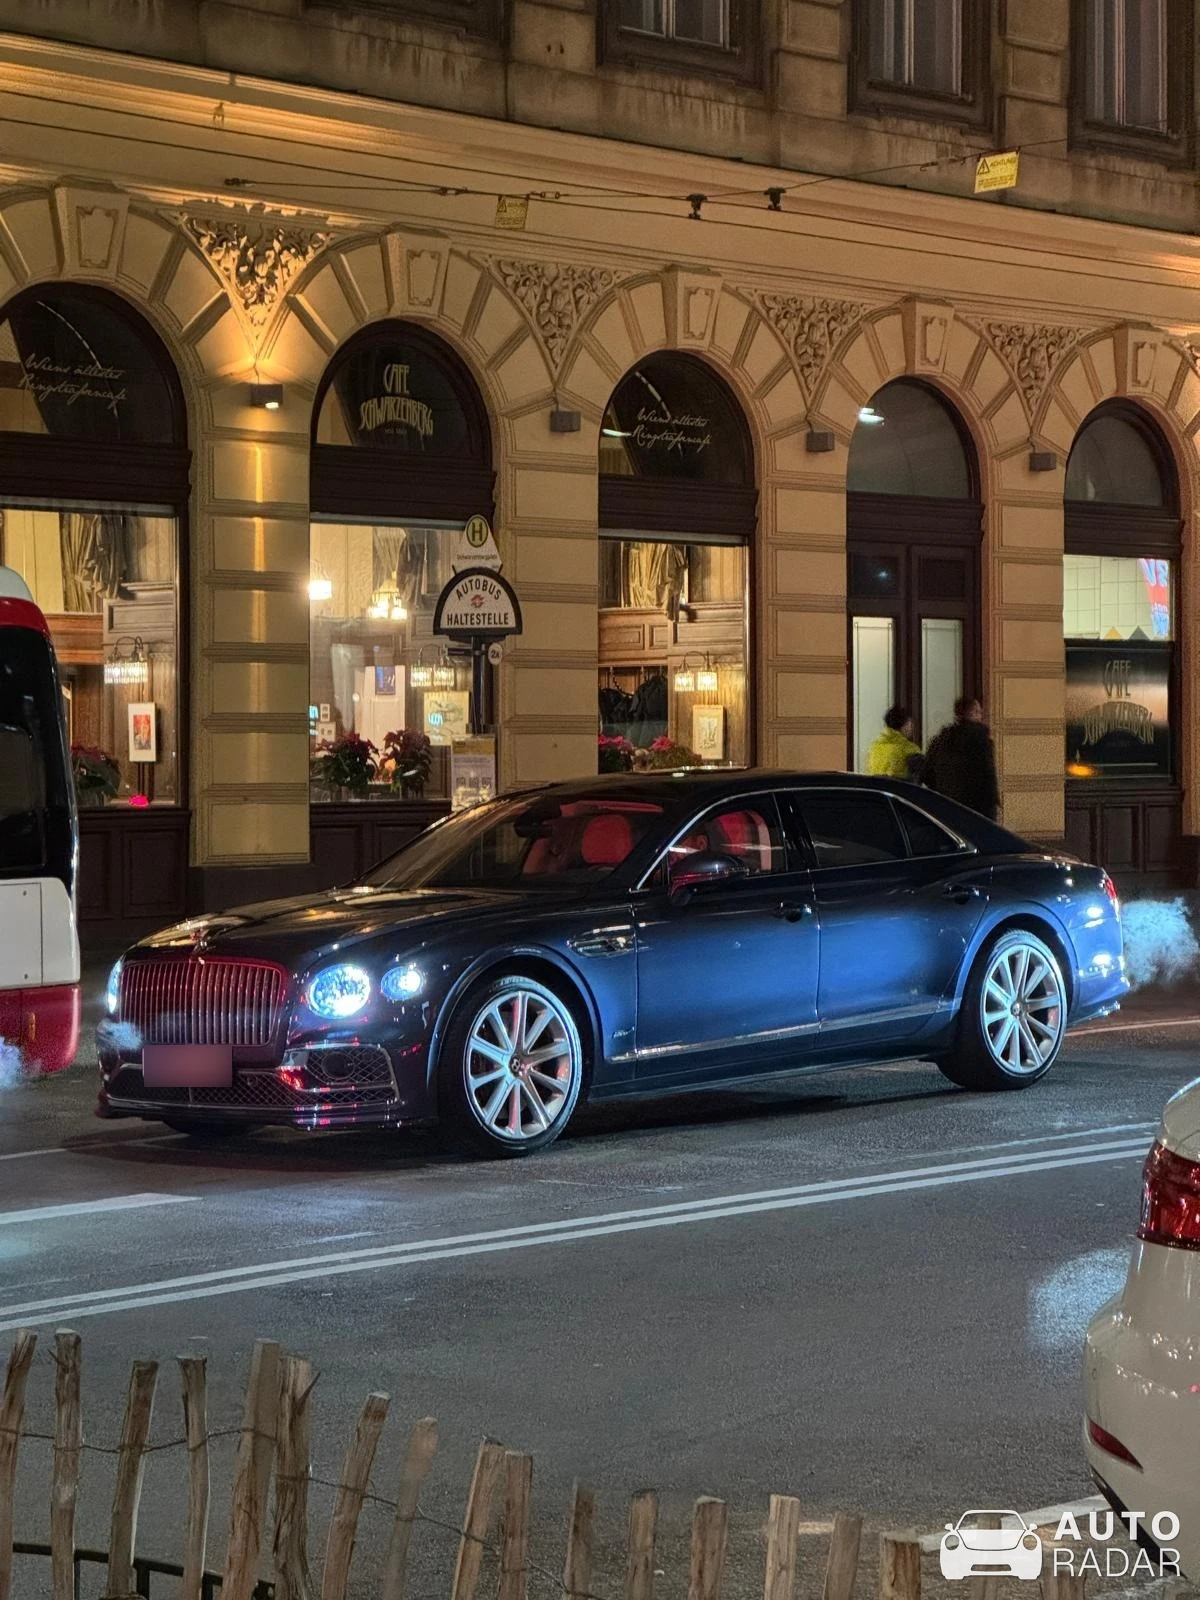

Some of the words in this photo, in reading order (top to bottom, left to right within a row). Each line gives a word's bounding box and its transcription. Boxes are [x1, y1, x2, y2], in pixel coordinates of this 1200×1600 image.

[25, 353, 70, 374] Wiens
[358, 395, 434, 436] SCHWARZENBERG
[638, 407, 671, 424] Wiens
[471, 522, 483, 542] H
[456, 578, 502, 601] AUTOBUS
[446, 612, 509, 626] HALTESTELLE
[491, 648, 500, 659] 2A
